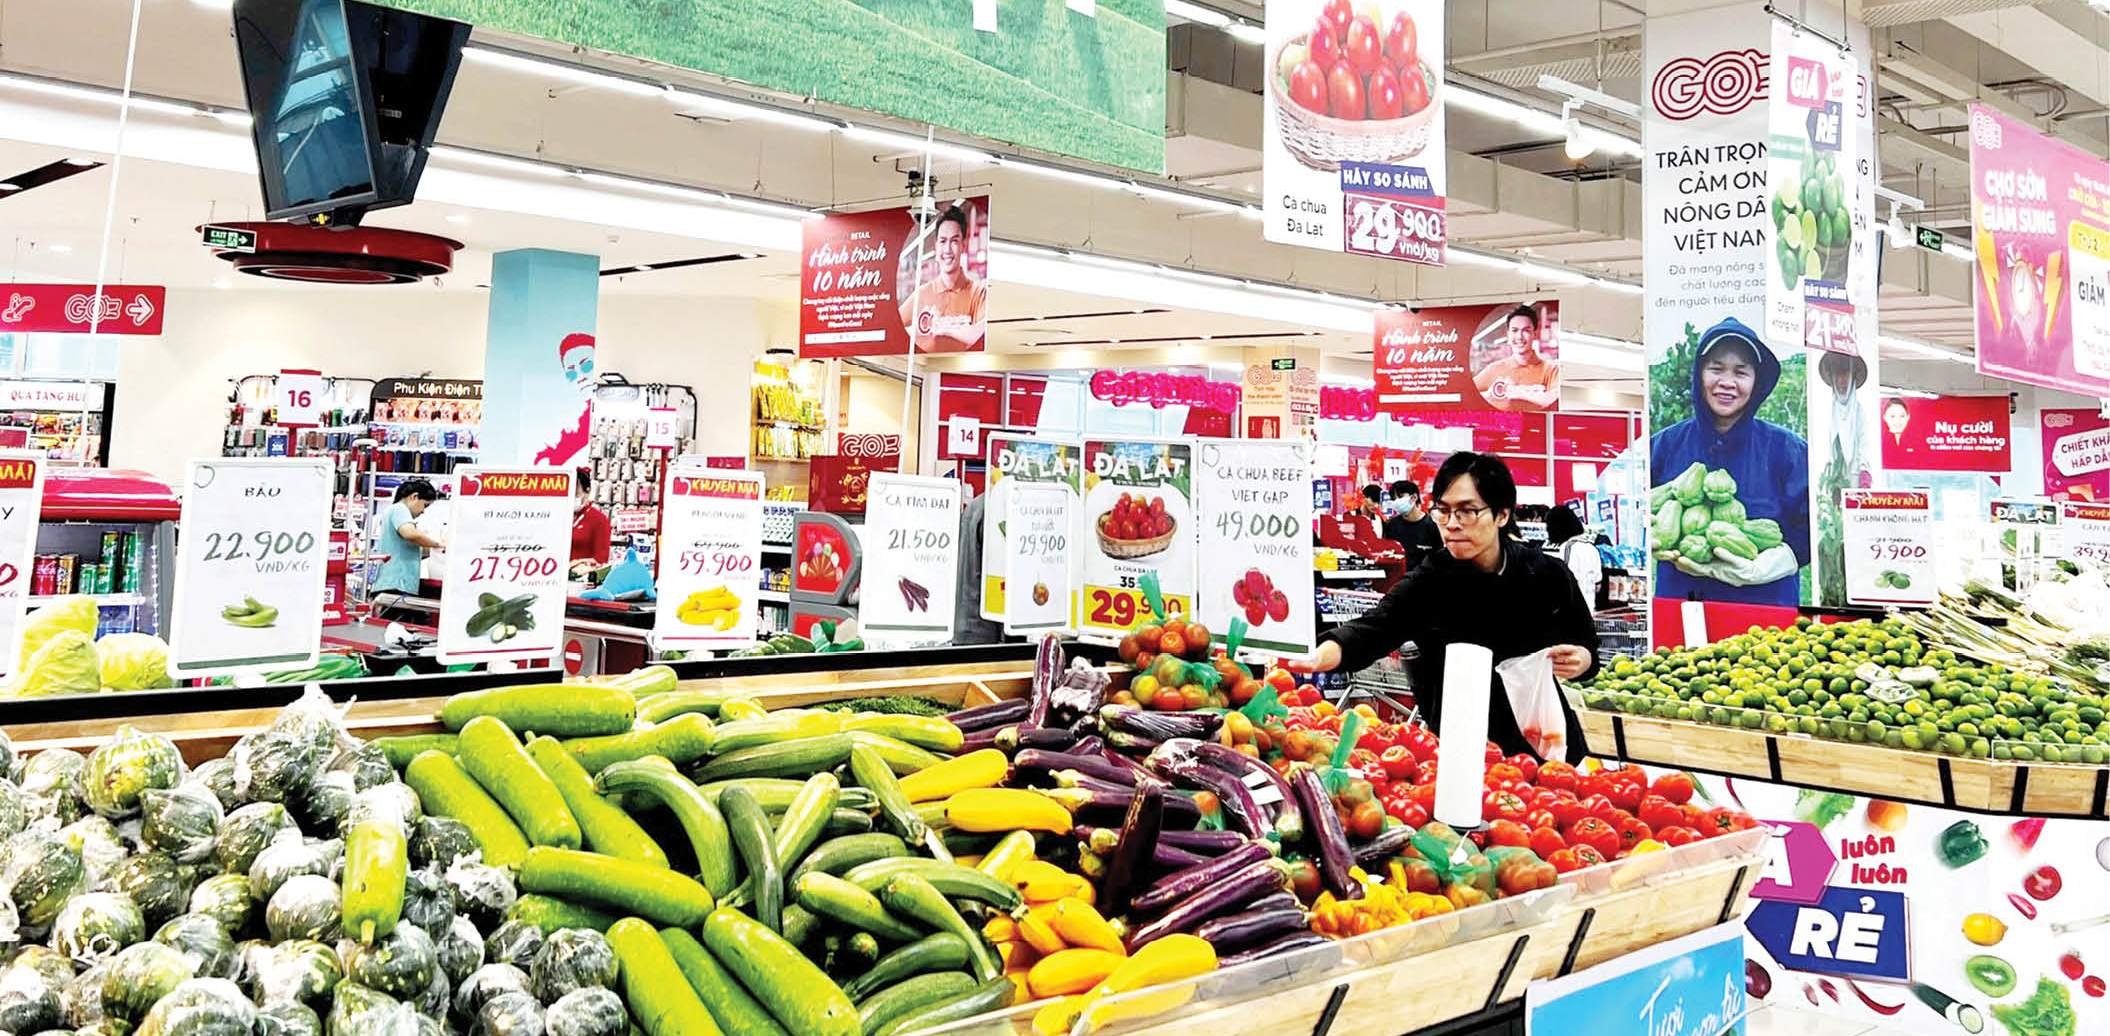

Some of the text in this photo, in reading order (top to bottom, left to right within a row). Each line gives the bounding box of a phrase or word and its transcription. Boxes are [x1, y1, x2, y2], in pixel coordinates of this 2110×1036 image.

[1656, 146, 1710, 169] TRÂN
[1374, 172, 1392, 187] SO
[1394, 171, 1429, 190] SÁNH
[1679, 170, 1728, 194] CẢM
[1301, 199, 1327, 215] chua
[1664, 202, 1731, 224] NÔNG
[1674, 229, 1718, 255] VIỆT
[851, 241, 887, 264] trình
[1689, 264, 1723, 276] mang
[1725, 261, 1756, 274] nông
[813, 266, 883, 294] 10 năm
[1423, 328, 1458, 345] trình
[1386, 345, 1455, 365] 10 năm
[287, 390, 312, 408] 16
[418, 382, 442, 397] Kiện
[655, 422, 670, 435] 15
[960, 428, 974, 443] 14
[1935, 420, 1994, 436] Nụ cười
[1926, 434, 2006, 447] của khách hàng
[1237, 467, 1269, 480] CHUA
[1272, 467, 1304, 481] BEEF
[1390, 466, 1400, 475] 11
[1262, 490, 1289, 504] GAP
[1216, 510, 1300, 541] 49.000
[203, 530, 315, 561] 22.900
[888, 528, 950, 550] 21.500
[1019, 534, 1066, 556] 29.900
[1254, 543, 1299, 558] VND/KG
[1870, 544, 1927, 560] 9.900
[255, 559, 311, 574] VND/KG
[468, 555, 558, 582] 27.900
[680, 551, 753, 576] 59.900
[1841, 835, 1896, 859] luôn
[1851, 863, 1908, 884] luôn
[1790, 896, 1886, 964] RẺ
